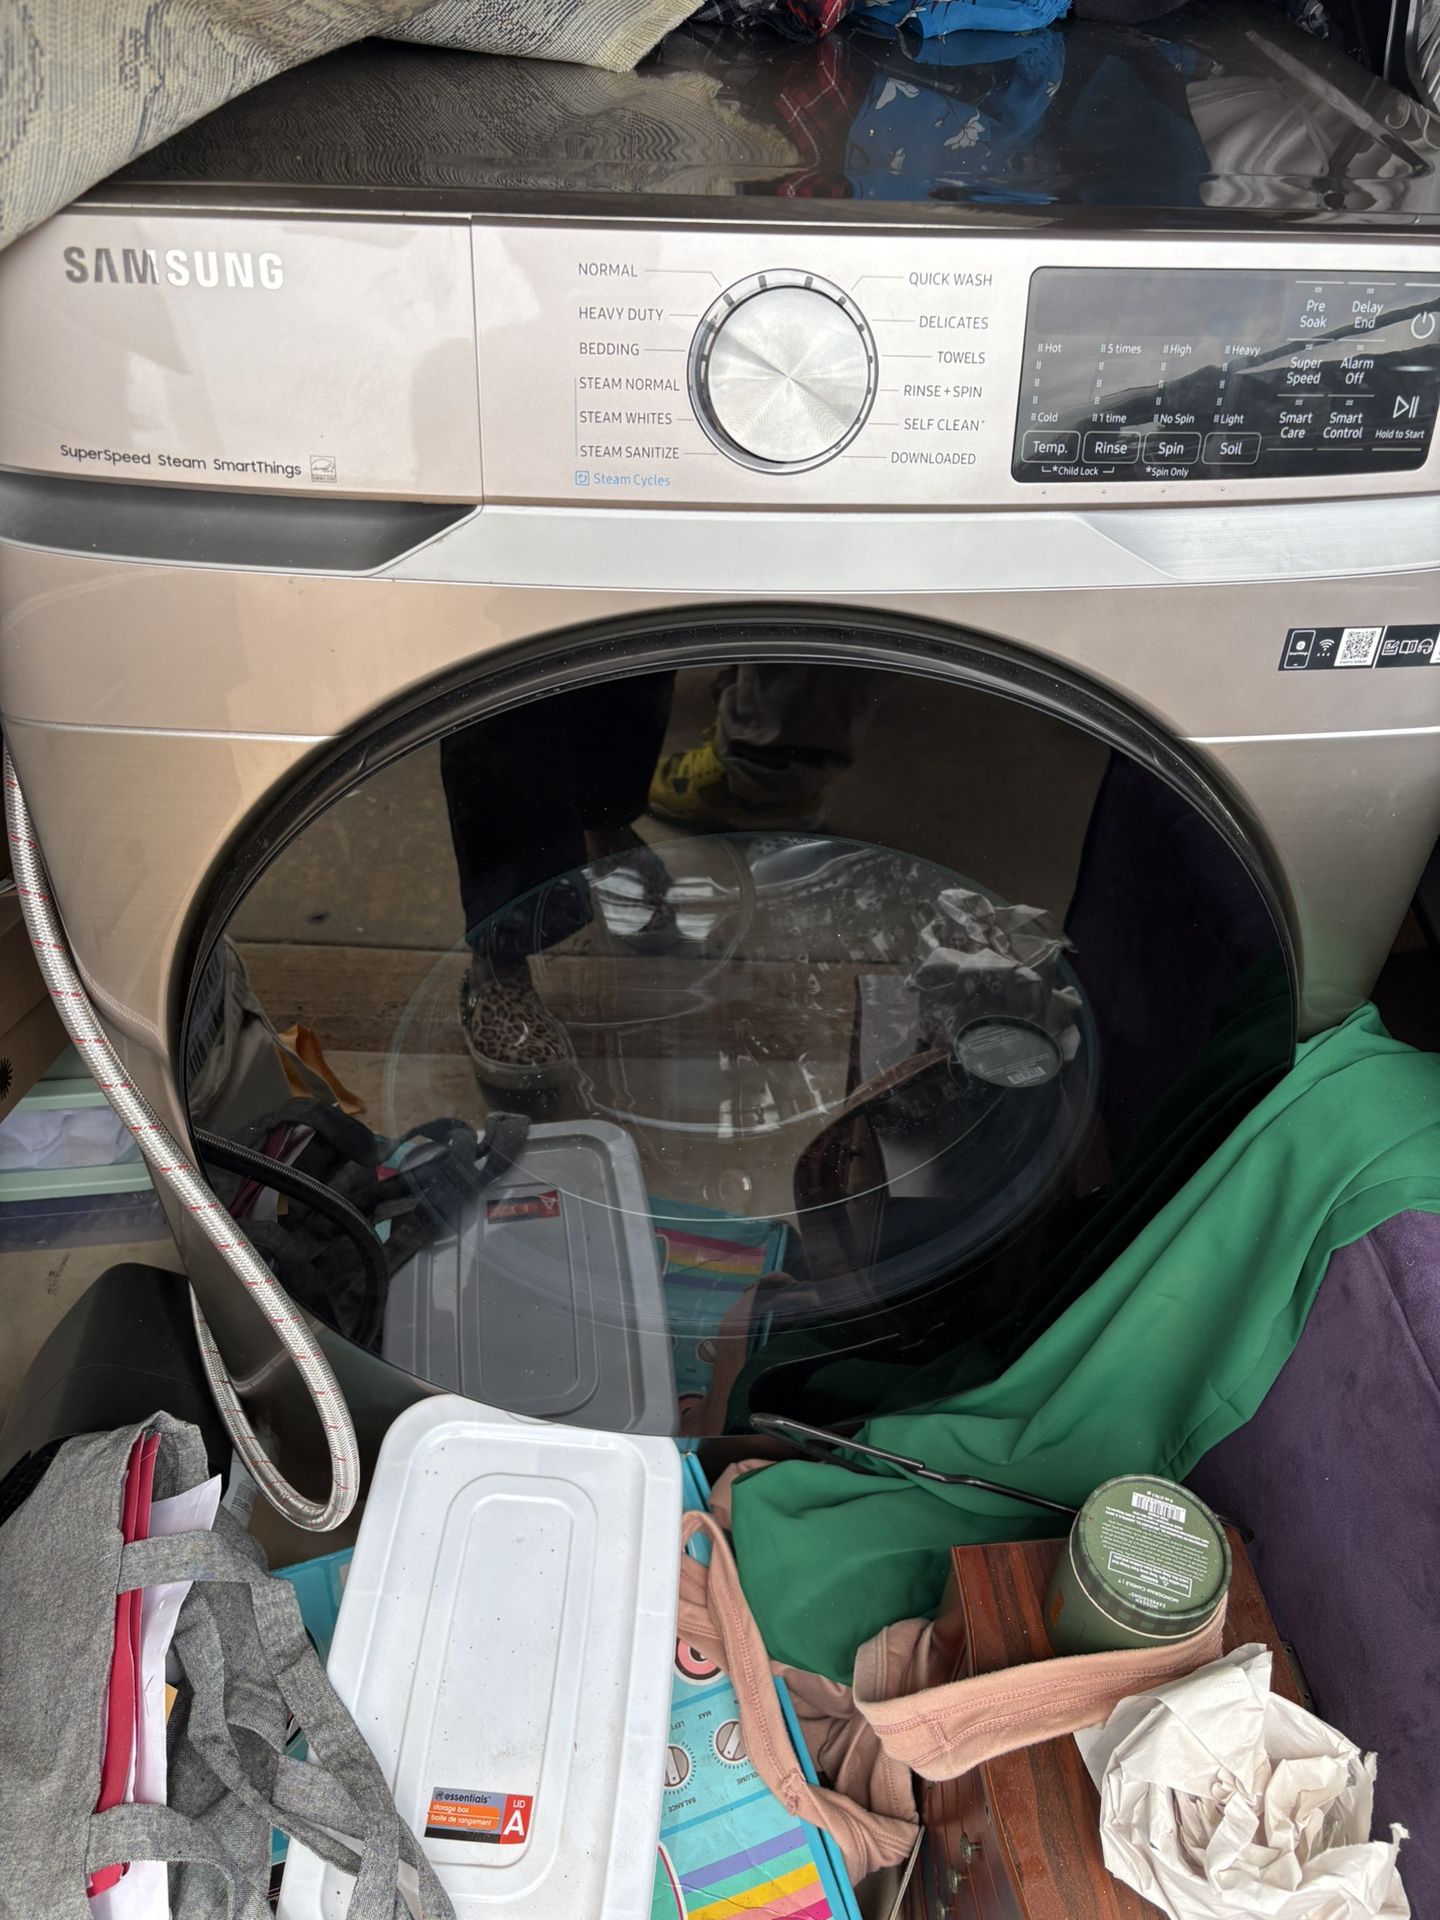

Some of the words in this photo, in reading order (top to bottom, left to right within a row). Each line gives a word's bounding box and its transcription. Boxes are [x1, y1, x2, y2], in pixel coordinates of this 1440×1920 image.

[63, 246, 284, 290] SAMSUNG
[578, 262, 638, 277] NORMAL
[909, 272, 950, 287] QUICK
[953, 273, 993, 287] WASH
[1306, 300, 1325, 312] Pre
[1352, 301, 1383, 315] Delay
[579, 307, 624, 320] HEAVY
[628, 308, 664, 321] DUTY
[919, 315, 989, 330] DELICATES
[1300, 316, 1327, 328] Soak
[1354, 317, 1375, 329] End
[579, 342, 640, 356] BEDDING
[1044, 344, 1062, 354] Hot
[1107, 344, 1114, 354] 5
[1116, 344, 1142, 354] times
[1170, 344, 1192, 357] High
[1232, 345, 1261, 357] Heavy
[937, 351, 986, 364] TOWELS
[1290, 357, 1322, 370] Super
[1340, 358, 1374, 369] Alarm
[579, 377, 622, 390] STEAM
[625, 378, 680, 391] NORMAL
[1286, 373, 1321, 387] Speed
[1345, 373, 1365, 385] Off
[580, 411, 622, 424] STEAM
[625, 412, 673, 425] WHITES
[1038, 412, 1058, 422] Cold
[1105, 413, 1127, 423] time
[1160, 414, 1173, 423] No
[1174, 414, 1195, 425] Spin
[1221, 414, 1244, 425] Light
[1279, 412, 1313, 424] Smart
[1329, 412, 1363, 424] Smart
[904, 418, 934, 430] SELF
[1280, 427, 1305, 439] Care
[1323, 427, 1363, 439] Control
[1375, 430, 1394, 439] Hold
[1395, 430, 1404, 439] to
[1404, 430, 1425, 439] Start
[580, 445, 622, 458] STEAM
[625, 446, 679, 459] SANITIZE
[1033, 441, 1068, 459] Temp.
[1094, 442, 1128, 454] Rinse
[1158, 442, 1184, 460] Spin
[1220, 443, 1242, 455] Soil
[60, 444, 151, 467] SuperSpeed
[158, 454, 206, 470] Steam
[213, 458, 302, 478] SmartThings
[891, 452, 976, 465] DOWNLOADED
[1080, 467, 1099, 476] Lock
[1170, 467, 1189, 478] Only
[593, 473, 631, 485] Steam
[633, 473, 671, 488] Cycles
[698, 1710, 712, 1719] MAX
[736, 1771, 759, 1785] OLUME
[445, 1792, 488, 1804] essentials
[513, 1800, 526, 1808] LID
[433, 1804, 456, 1813] storage
[668, 1797, 696, 1813] BALANCE
[457, 1816, 492, 1825] rangement
[503, 1810, 525, 1836] A
